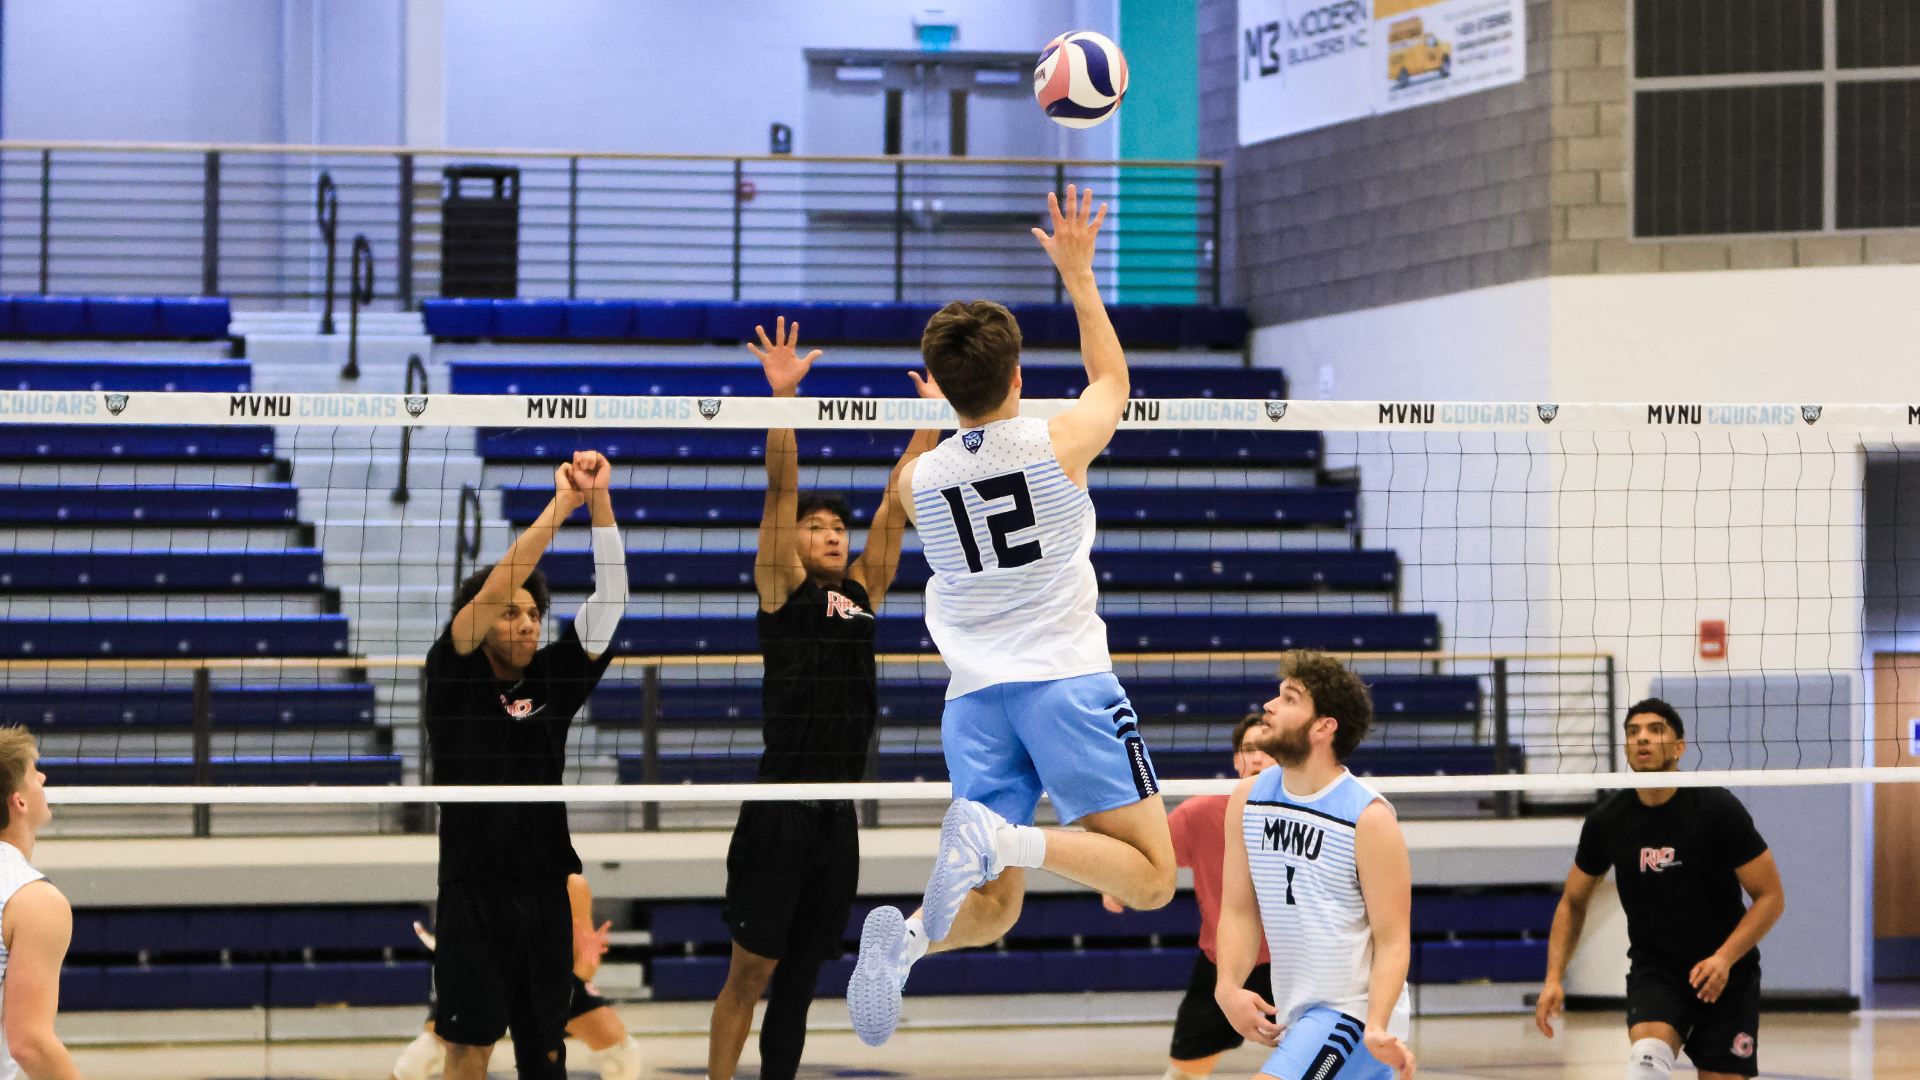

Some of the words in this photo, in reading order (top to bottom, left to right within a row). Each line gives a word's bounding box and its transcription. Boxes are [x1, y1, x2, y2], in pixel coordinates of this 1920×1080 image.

[0, 393, 97, 415] COUGARS
[230, 395, 291, 416] MVNU
[299, 396, 397, 418] COUGARS
[527, 397, 587, 419] MVNU
[594, 398, 691, 420] COUGARS
[818, 400, 877, 421] MVNU
[884, 400, 958, 421] COUGA
[1122, 400, 1160, 422] VNU
[1166, 401, 1258, 422] COUGARS
[1378, 403, 1435, 424] MVNU
[1441, 404, 1531, 425] COUGARS
[1647, 404, 1702, 425] MVNU
[1708, 405, 1795, 425] COUGARS
[940, 470, 1043, 574] 12
[1261, 817, 1325, 861] MVNU
[1285, 863, 1296, 906] 1
